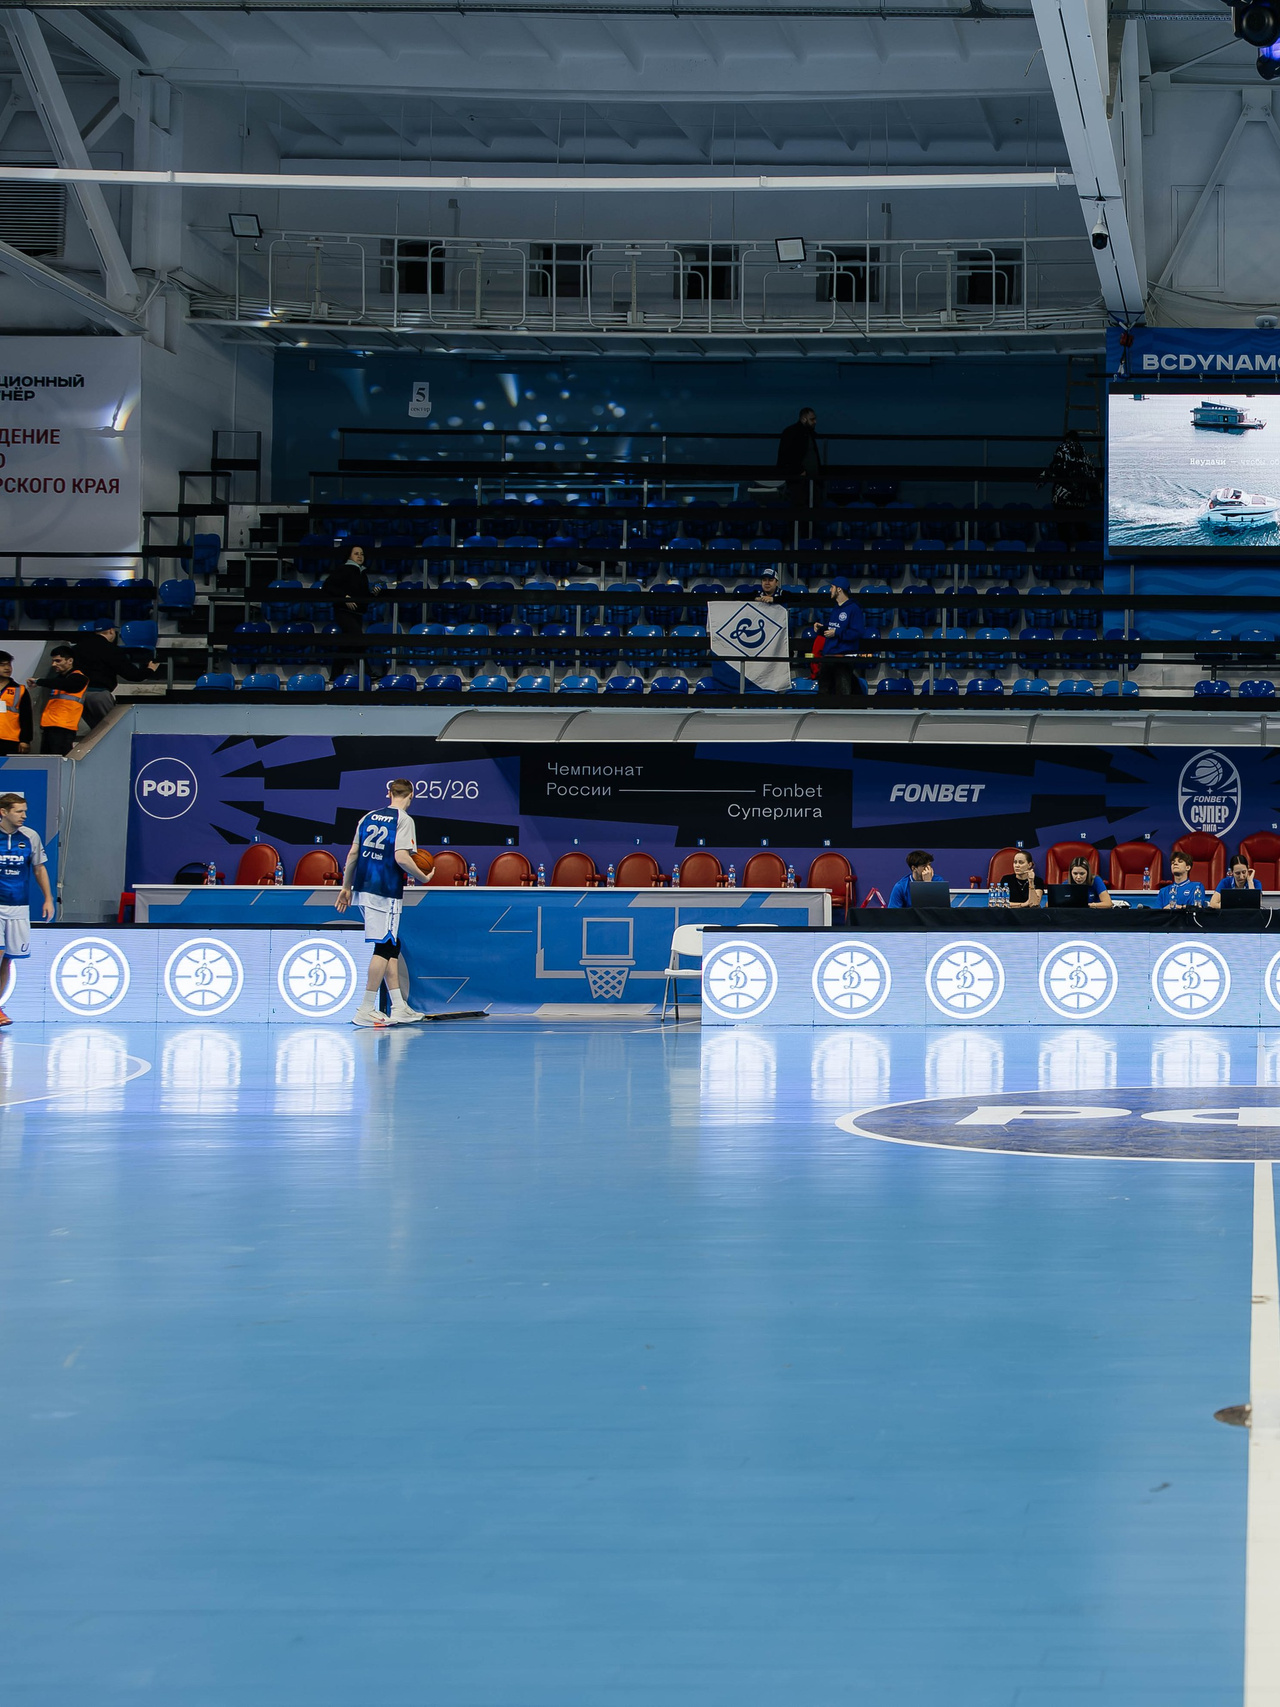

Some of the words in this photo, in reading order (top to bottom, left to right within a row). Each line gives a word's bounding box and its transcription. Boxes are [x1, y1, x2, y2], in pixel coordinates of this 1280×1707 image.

[0, 387, 35, 401] НЁР
[415, 387, 426, 402] 5
[72, 478, 120, 494] КРАЯ
[547, 762, 644, 776] Чемпионат
[142, 780, 190, 797] РФБ
[385, 779, 479, 800] 25/26
[546, 782, 612, 796] России
[762, 783, 823, 798] Fonbet
[889, 783, 986, 802] FONBET
[1193, 795, 1228, 803] FONBET
[727, 803, 823, 820] Суперлига
[1190, 805, 1230, 823] СУПЕР
[362, 824, 389, 850] 22
